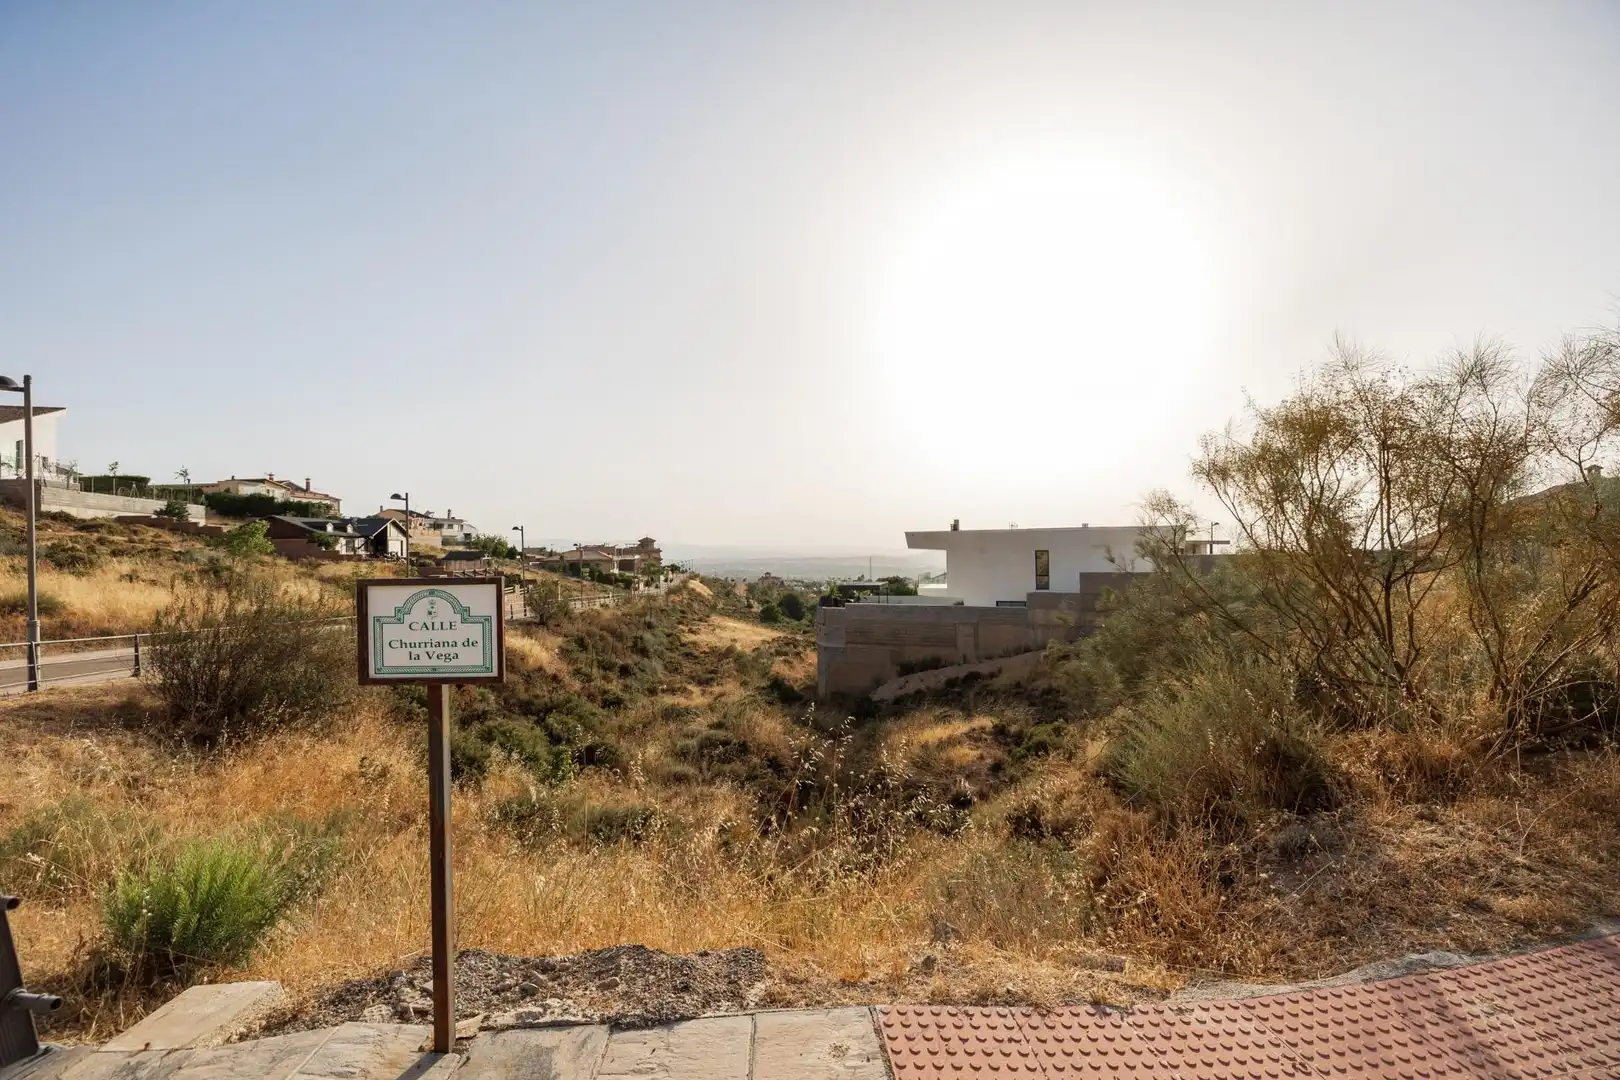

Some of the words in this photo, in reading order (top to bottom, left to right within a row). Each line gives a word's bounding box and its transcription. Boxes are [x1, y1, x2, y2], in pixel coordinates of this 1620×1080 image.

[408, 621, 458, 631] CALLE
[388, 638, 458, 649] Churriana
[461, 637, 479, 648] de
[408, 651, 421, 661] la
[425, 650, 460, 663] Vega
